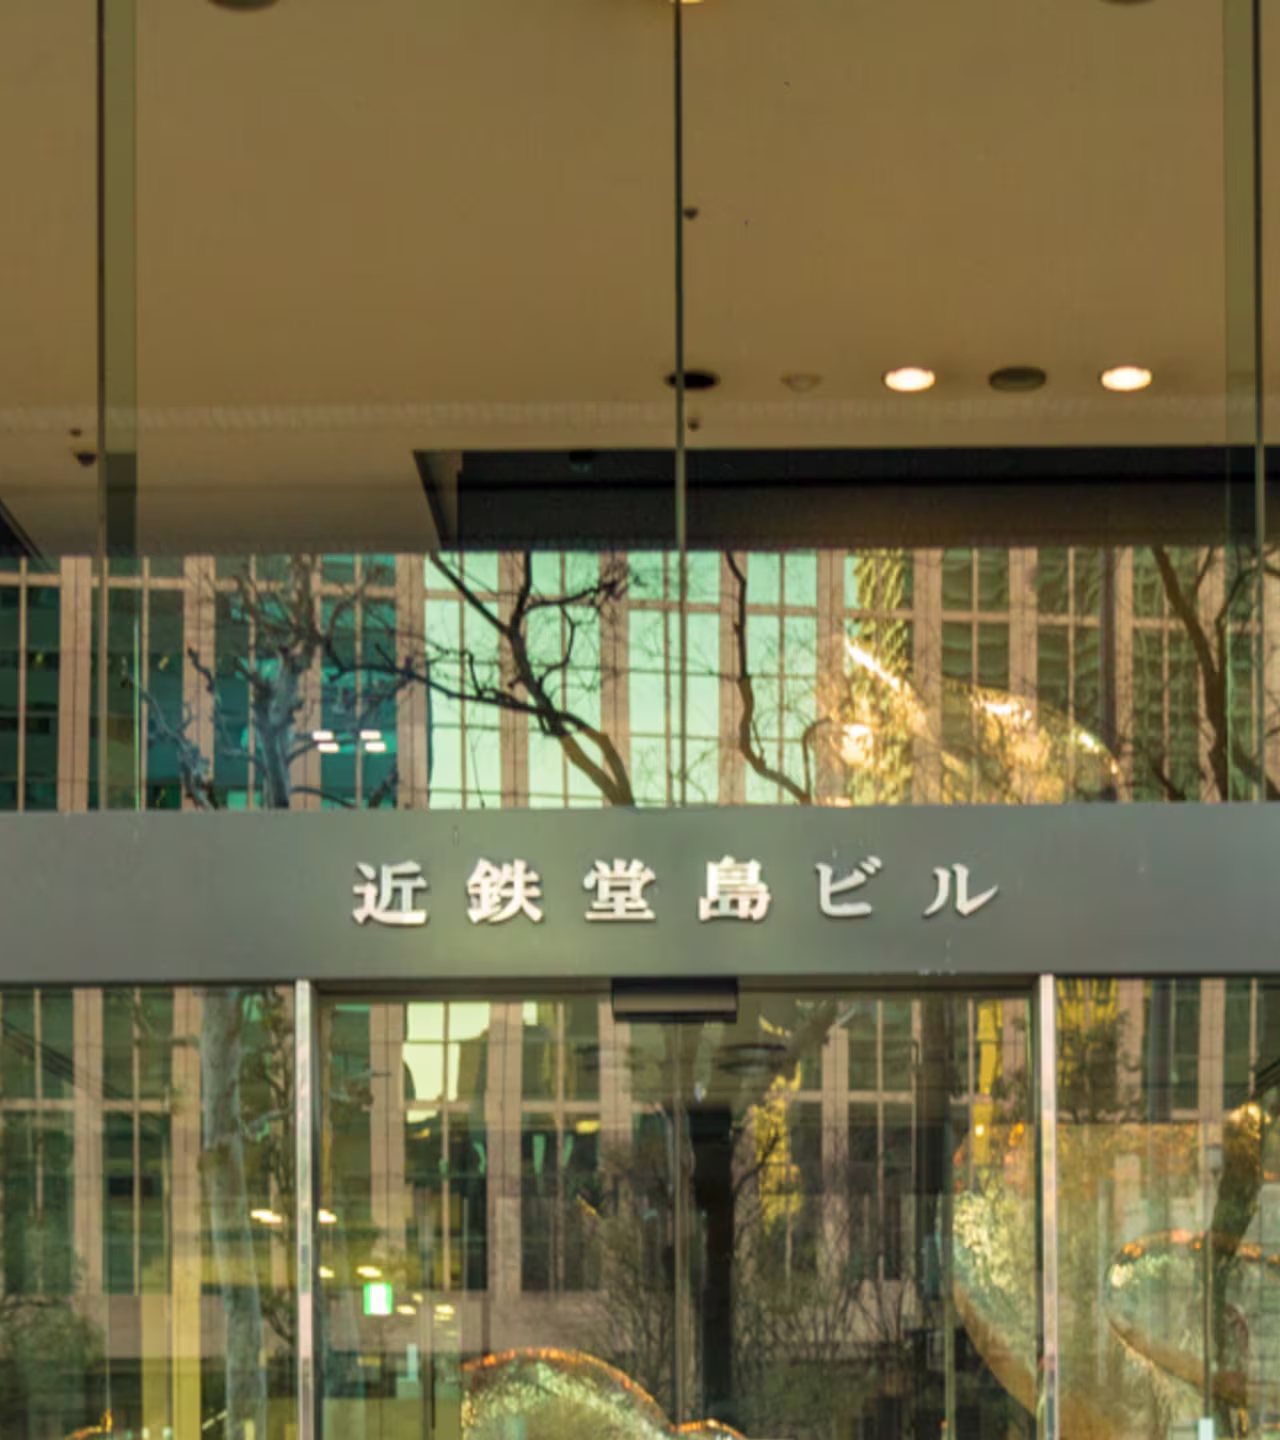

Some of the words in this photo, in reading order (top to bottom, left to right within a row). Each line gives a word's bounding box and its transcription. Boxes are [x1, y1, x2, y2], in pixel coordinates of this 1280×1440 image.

[352, 858, 999, 926] 近鉄堂島ビル
